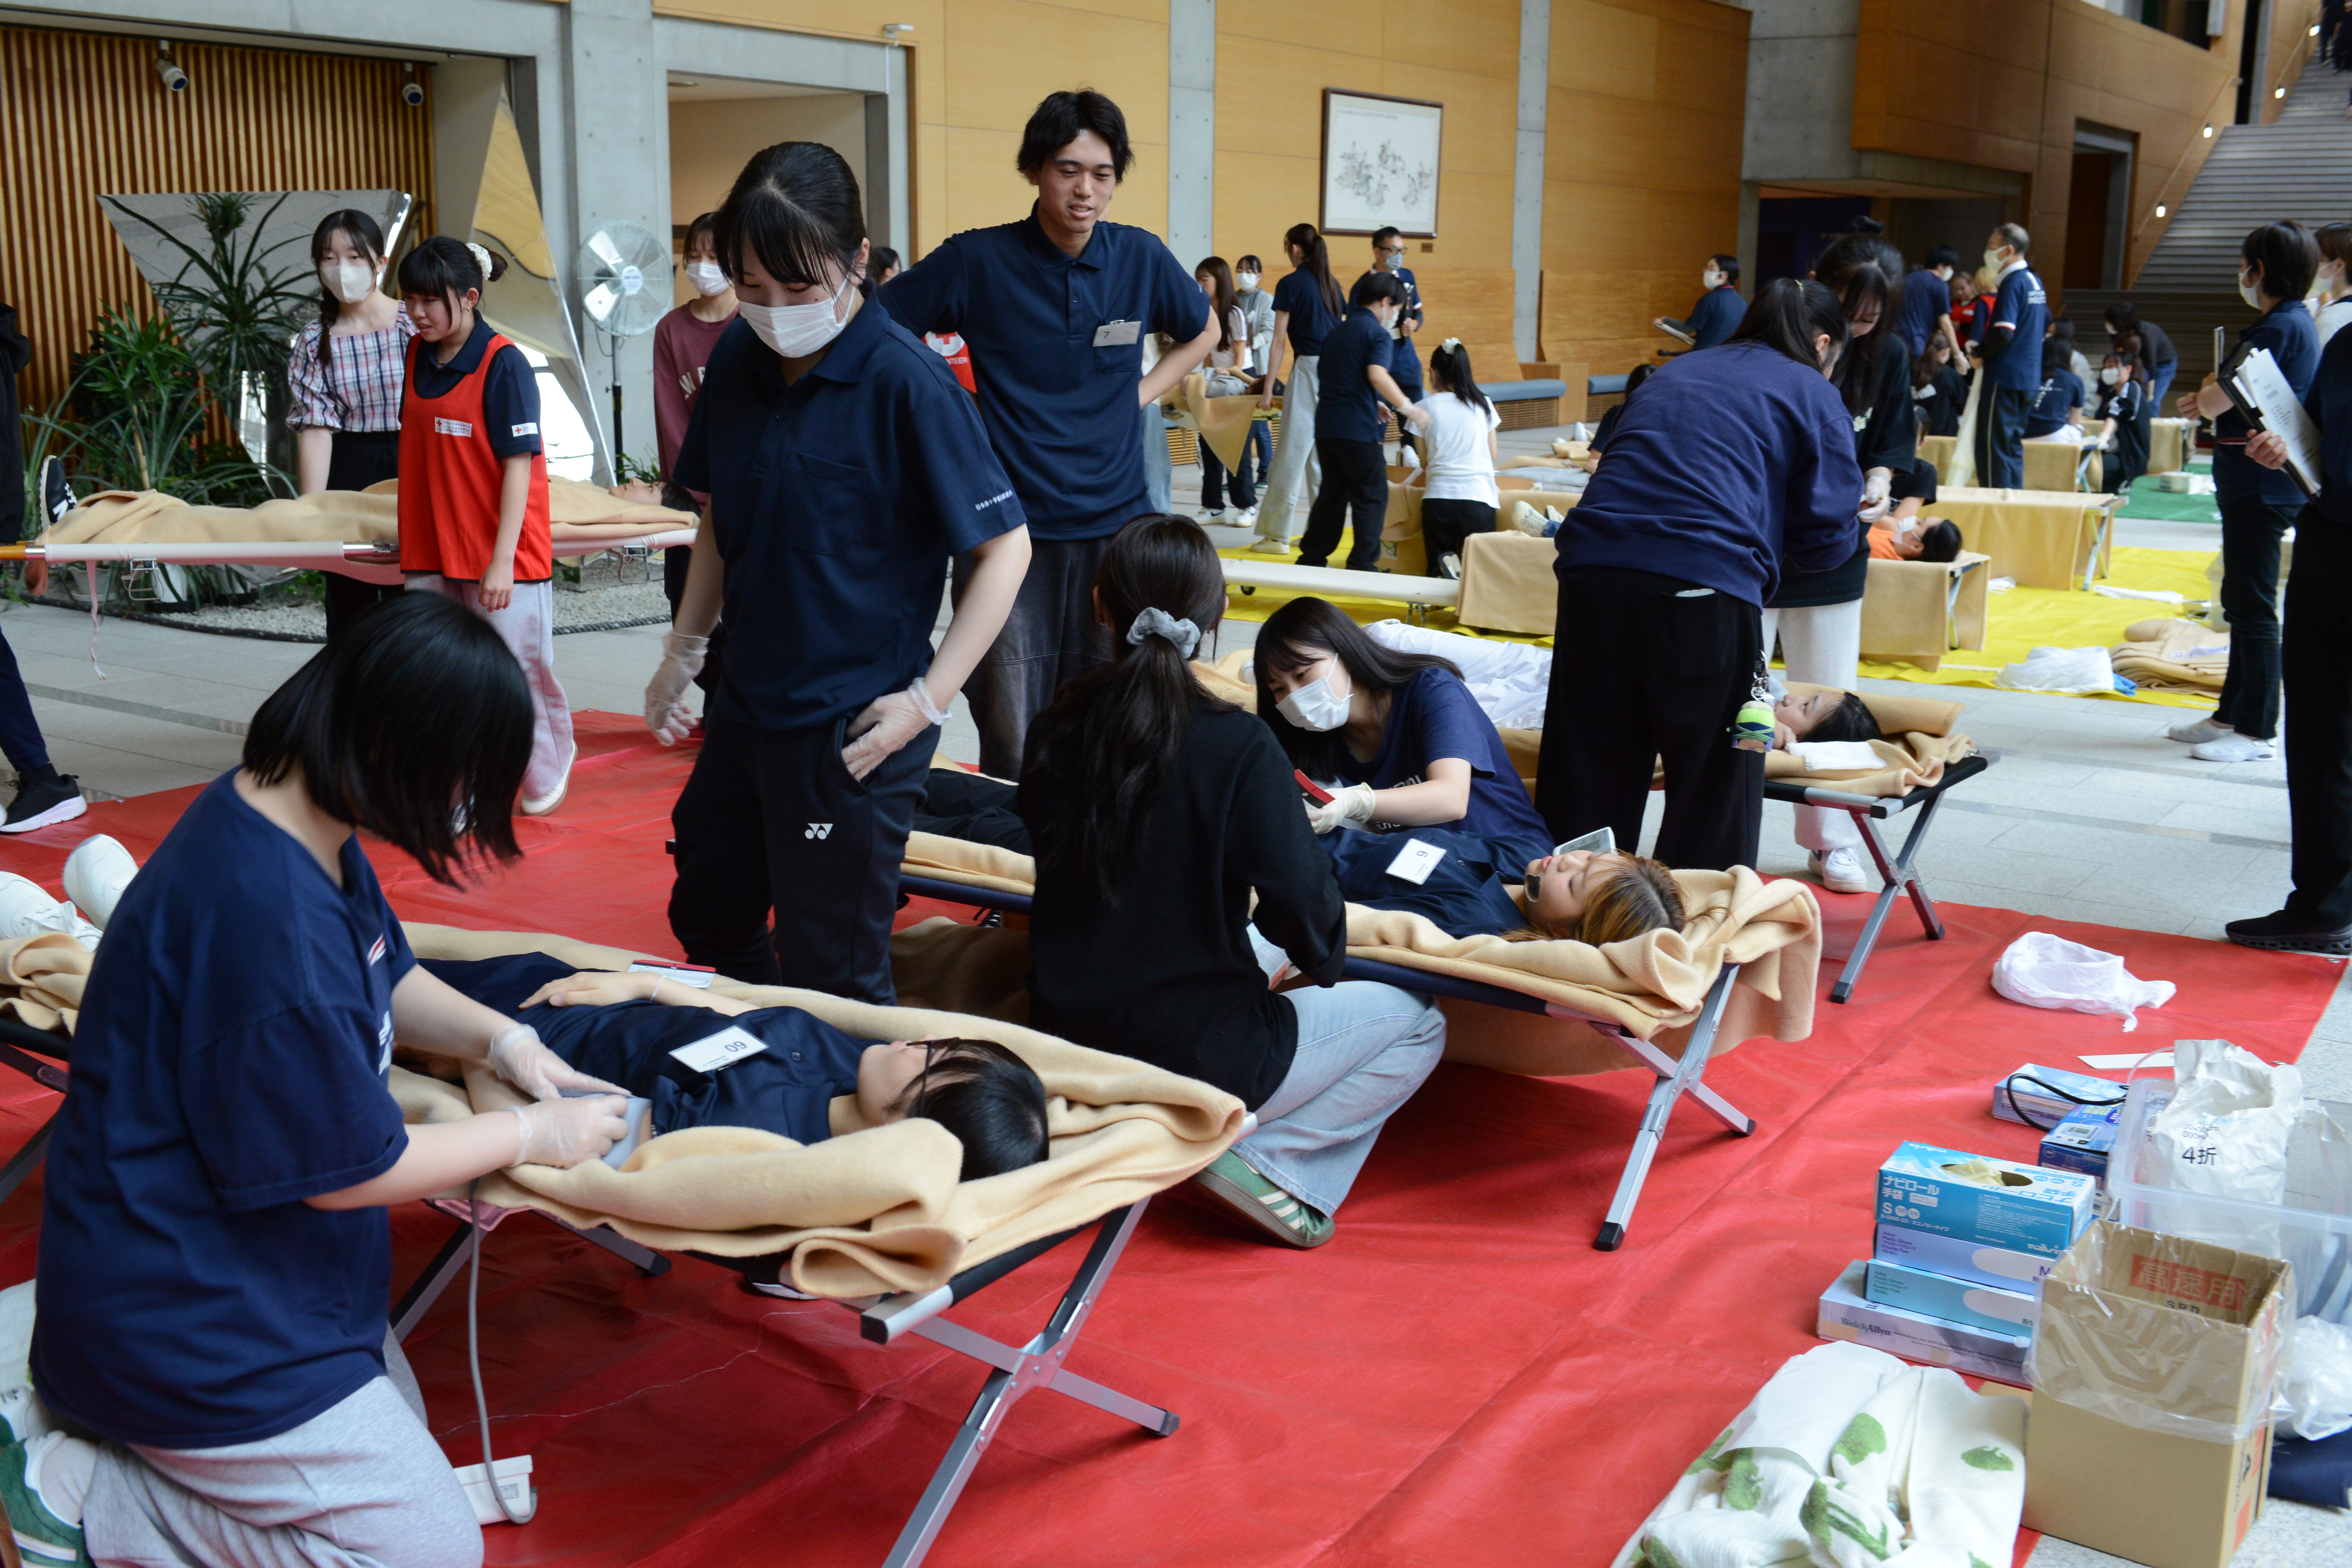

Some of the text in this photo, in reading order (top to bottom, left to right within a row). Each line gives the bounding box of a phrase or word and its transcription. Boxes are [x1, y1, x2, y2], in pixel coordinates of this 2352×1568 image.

[2182, 1146, 2217, 1166] 4折
[1882, 1176, 1940, 1195] ナビロール
[1882, 1188, 1904, 1200] 手袋
[1983, 1185, 2073, 1203] ナビロール
[2044, 1188, 2077, 1197] 手袋
[1882, 1202, 1893, 1214] S
[2027, 1243, 2063, 1254] navi
[2039, 1265, 2051, 1276] M
[2138, 1261, 2238, 1306] 高速用
